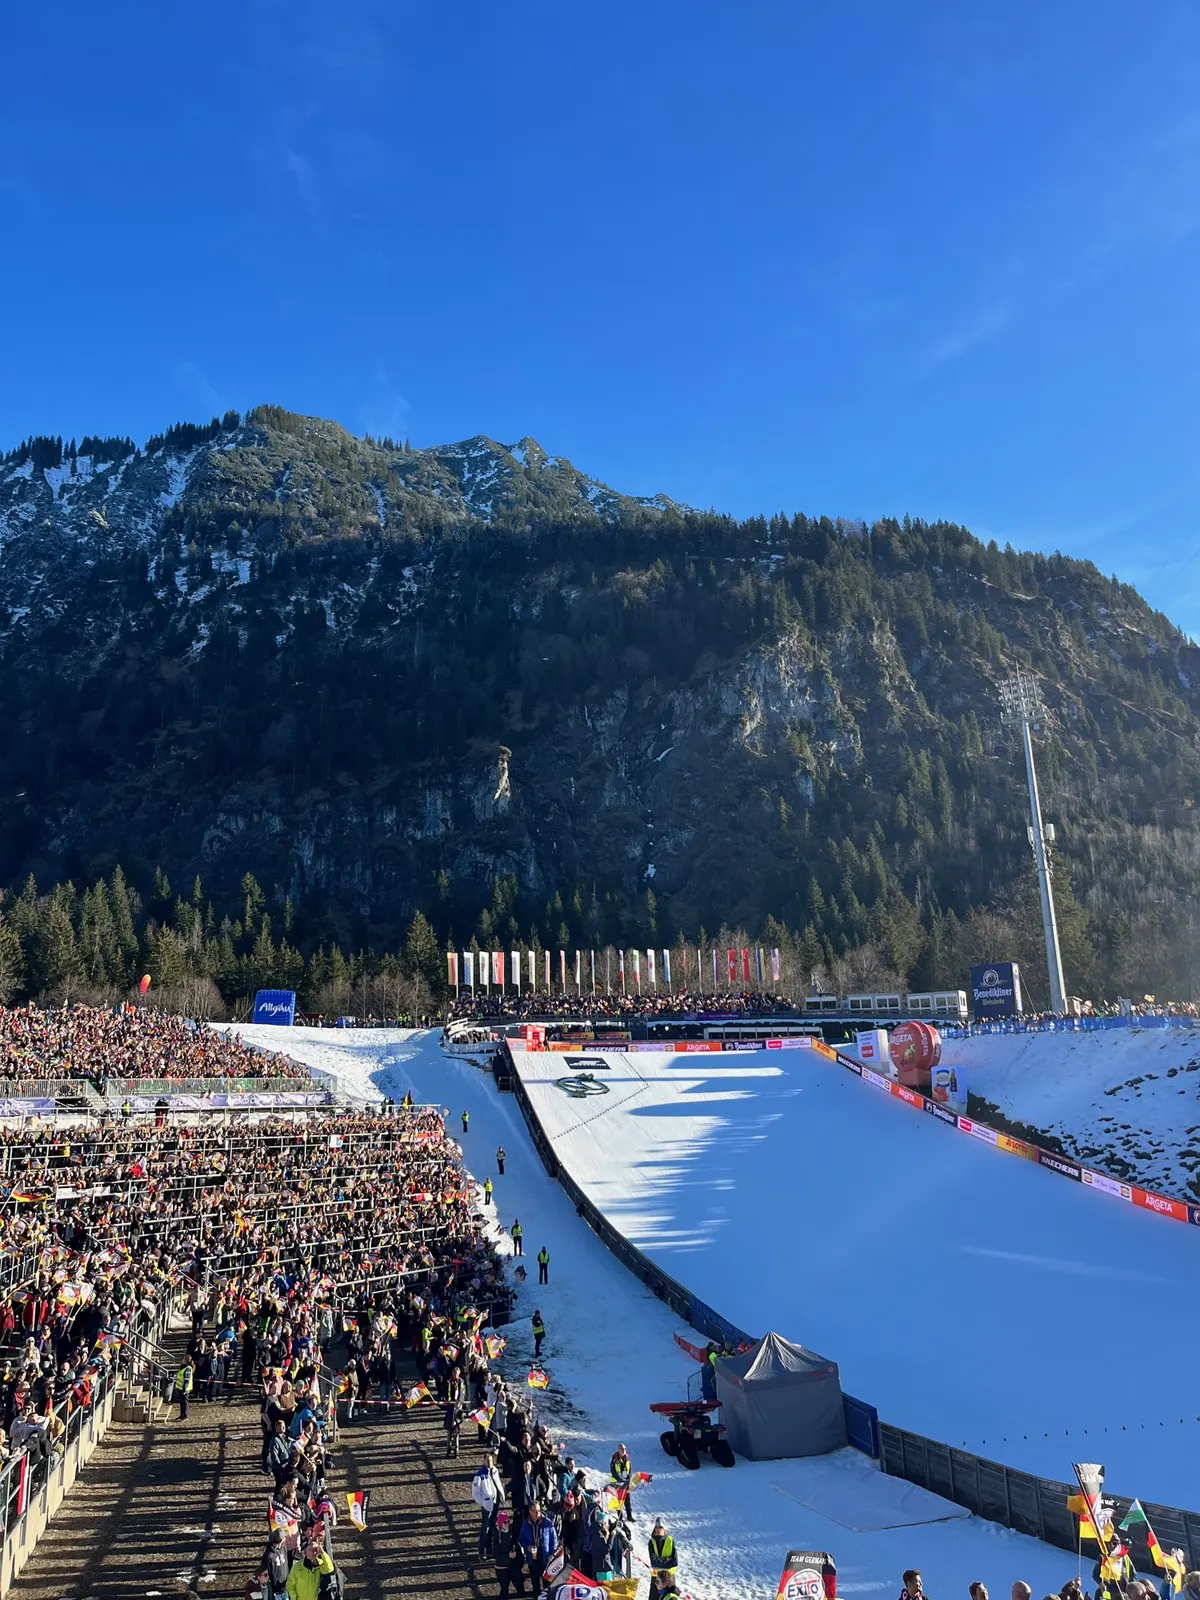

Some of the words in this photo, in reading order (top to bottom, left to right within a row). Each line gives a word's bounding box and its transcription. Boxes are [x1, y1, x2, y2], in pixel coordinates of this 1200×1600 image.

[973, 987, 1012, 1000] Benediktiner
[259, 1002, 292, 1017] Allgäu
[686, 1043, 710, 1052] ARGETA
[1040, 1156, 1080, 1177] SKECHERS
[1145, 1194, 1173, 1213] ARGETA
[790, 1555, 804, 1563] TEAM
